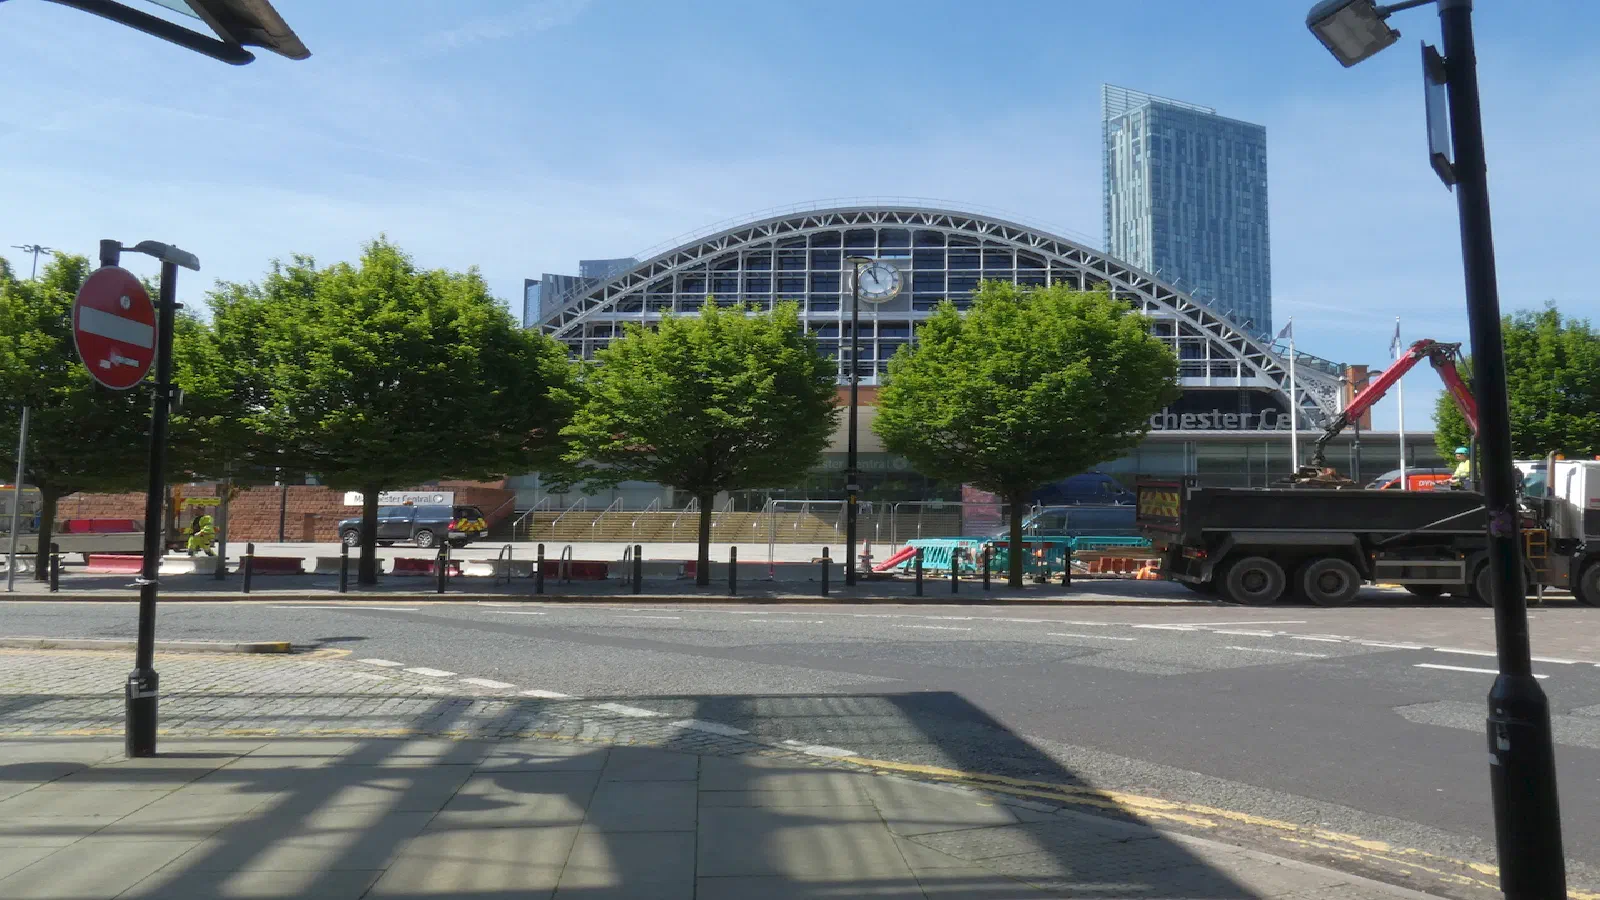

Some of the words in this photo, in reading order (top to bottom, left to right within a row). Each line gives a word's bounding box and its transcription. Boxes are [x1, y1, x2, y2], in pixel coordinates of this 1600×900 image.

[1150, 407, 1252, 430] chester
[1259, 408, 1292, 429] Ce
[856, 459, 890, 469] entral
